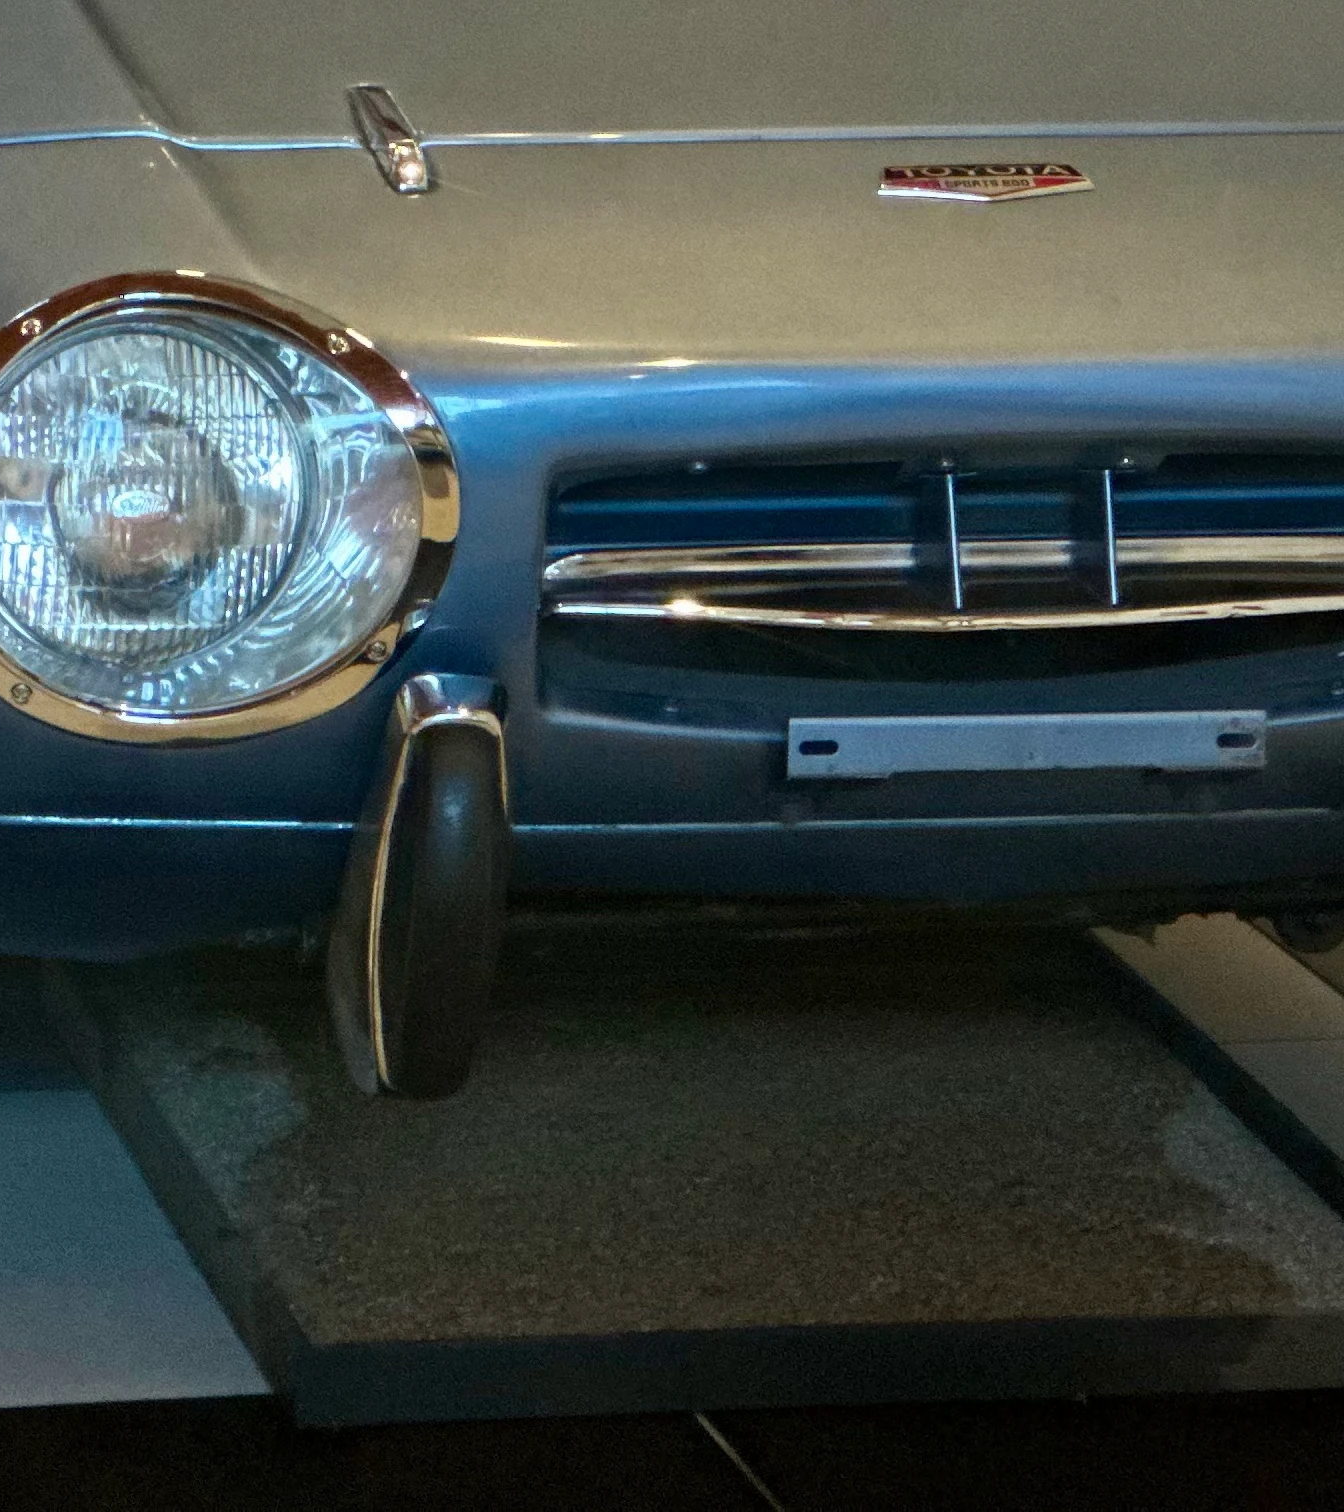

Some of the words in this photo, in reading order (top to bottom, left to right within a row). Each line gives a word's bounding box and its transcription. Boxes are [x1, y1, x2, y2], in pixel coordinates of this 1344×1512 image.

[888, 164, 1072, 178] TOYOTA
[944, 179, 999, 188] SPORTS
[1001, 179, 1030, 187] 800
